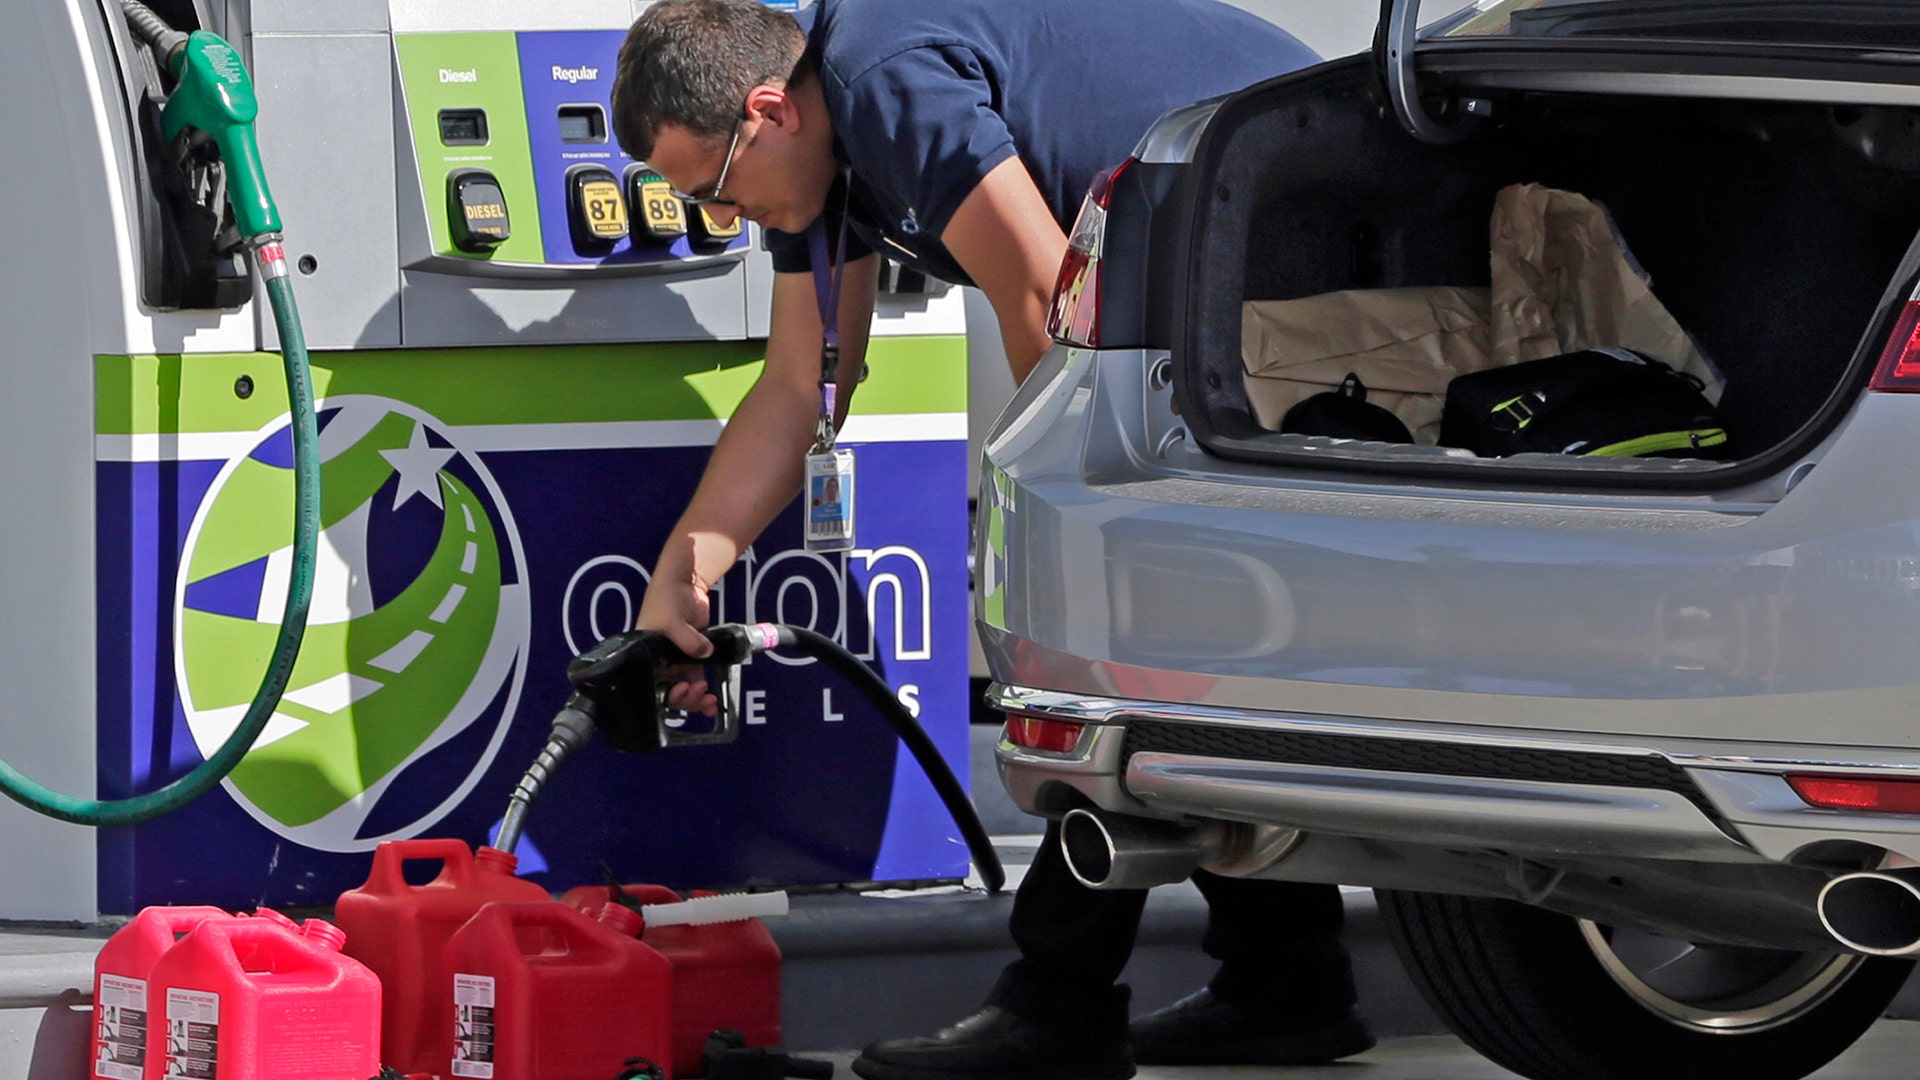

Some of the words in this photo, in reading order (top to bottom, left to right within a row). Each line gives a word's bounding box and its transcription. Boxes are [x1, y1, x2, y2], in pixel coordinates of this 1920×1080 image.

[439, 68, 477, 83] Diesel
[552, 65, 598, 83] Regular
[465, 204, 505, 220] DIESEL
[590, 199, 618, 221] 87
[648, 199, 679, 221] 89
[292, 352, 307, 417] FUTURA
